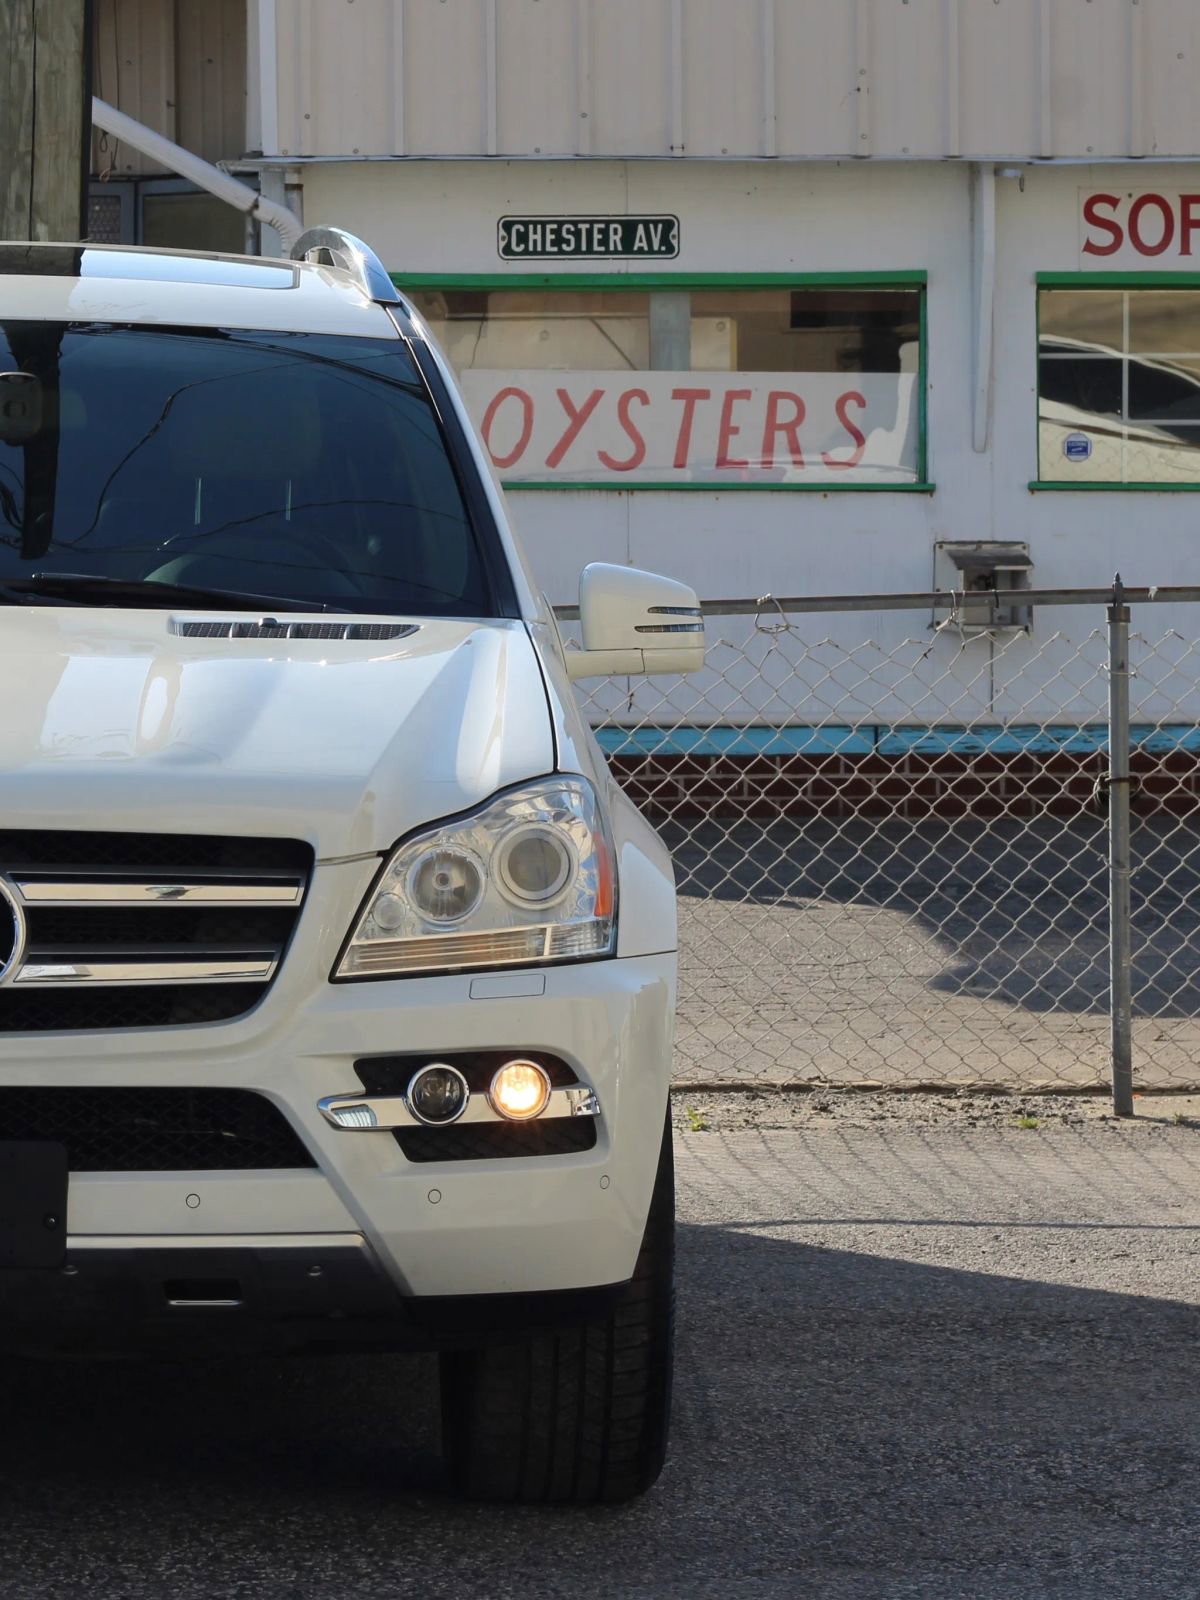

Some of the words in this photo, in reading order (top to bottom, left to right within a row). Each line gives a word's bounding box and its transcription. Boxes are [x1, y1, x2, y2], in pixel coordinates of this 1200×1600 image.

[510, 223, 623, 252] CHESTER
[633, 223, 666, 251] AV.
[481, 386, 867, 472] OYSTERS
